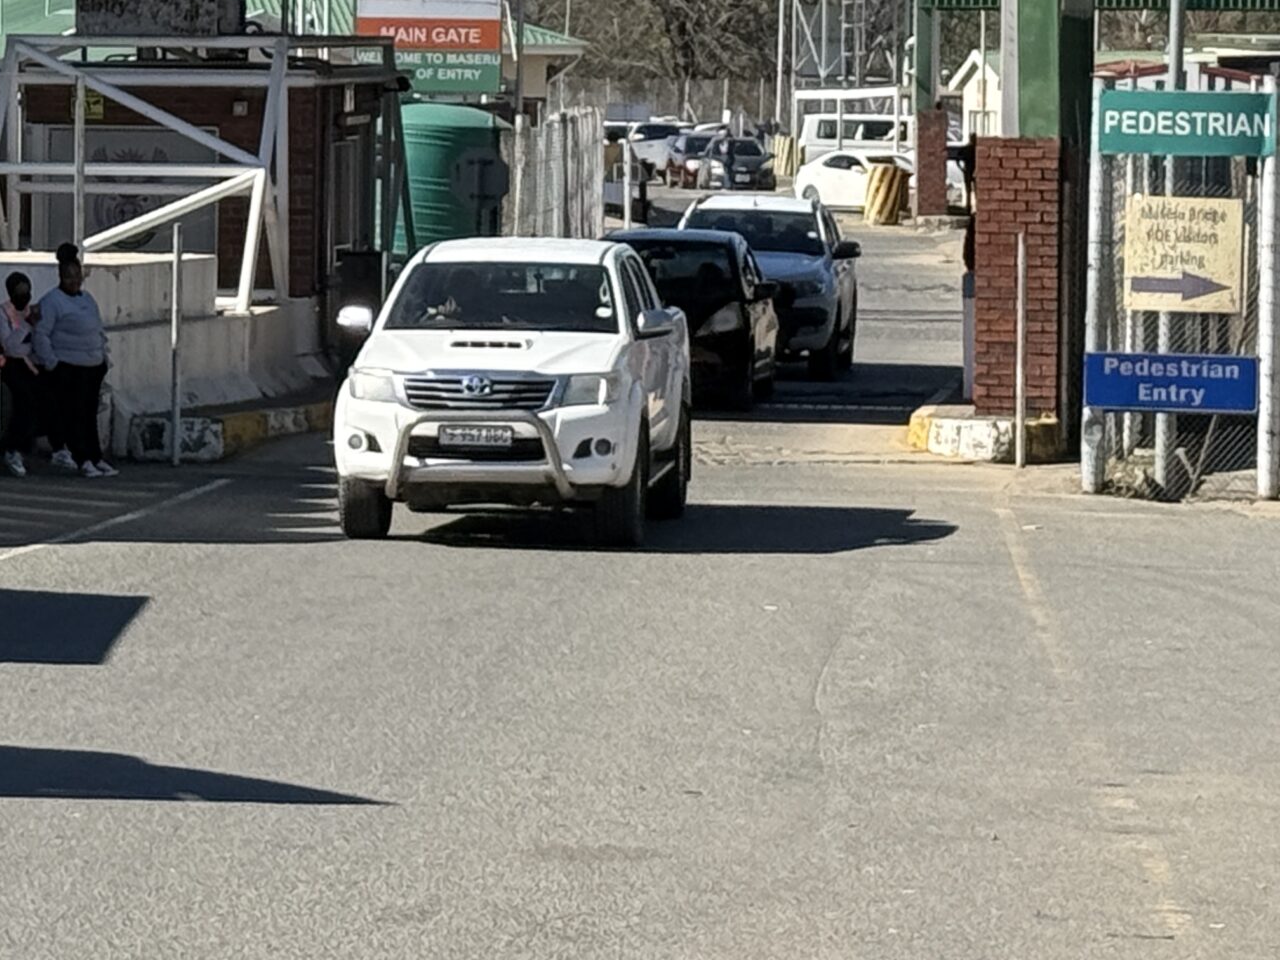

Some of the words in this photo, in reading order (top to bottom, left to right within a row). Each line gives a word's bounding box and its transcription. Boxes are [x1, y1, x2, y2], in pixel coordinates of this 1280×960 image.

[380, 26, 427, 43] MAIN
[432, 27, 481, 44] GATE
[425, 53, 444, 64] TO
[446, 53, 500, 65] MASERU
[416, 68, 434, 79] OF
[437, 69, 482, 80] ENTRY
[1104, 110, 1270, 137] PEDESTRIAN
[1104, 357, 1240, 379] Pedestrian
[1138, 383, 1206, 406] Entry
